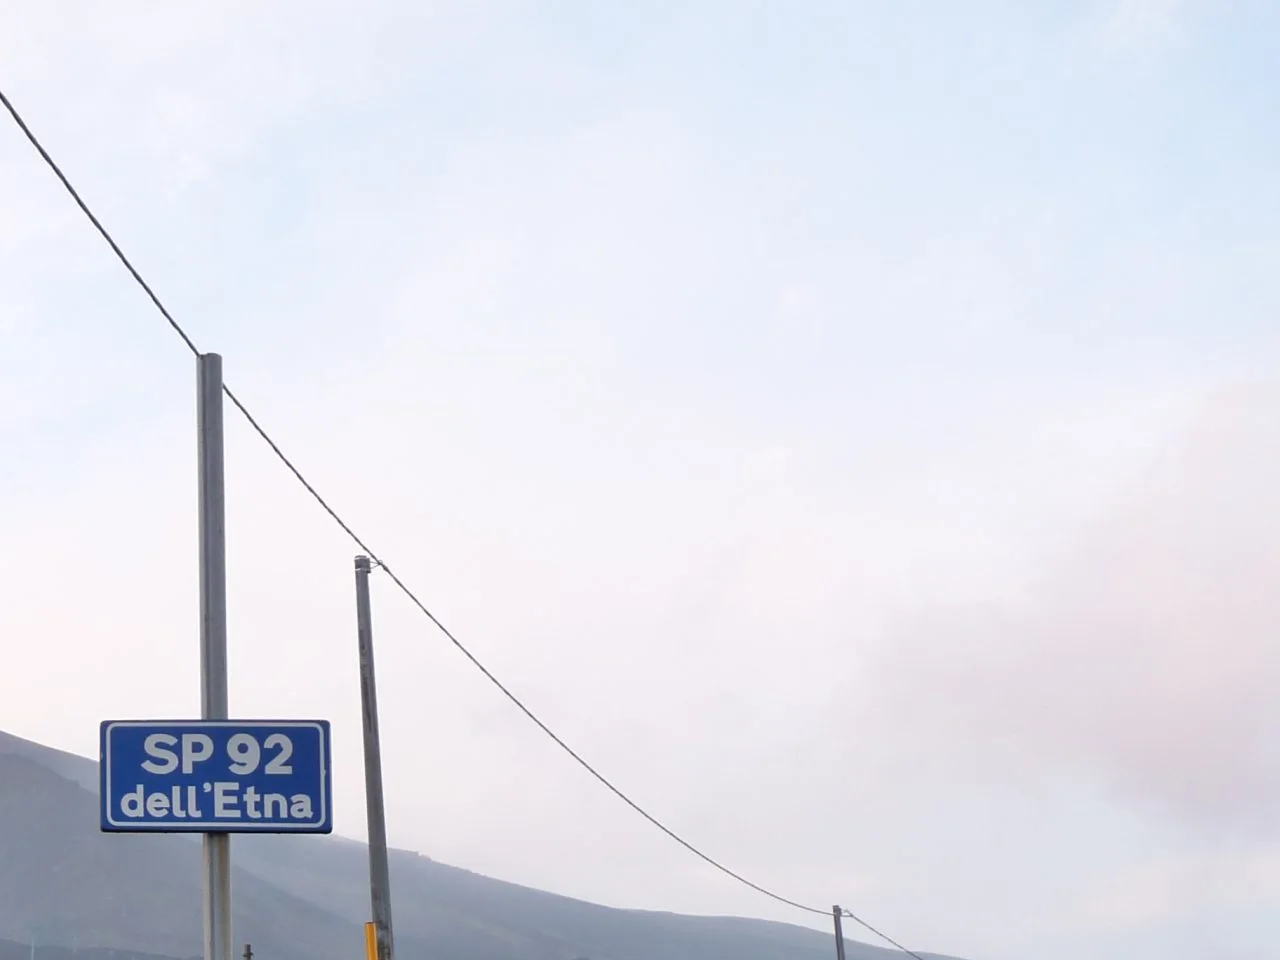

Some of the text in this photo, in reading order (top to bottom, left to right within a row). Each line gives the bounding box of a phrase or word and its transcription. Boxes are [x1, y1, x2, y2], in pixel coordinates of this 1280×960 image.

[140, 733, 293, 775] SP 92
[120, 781, 314, 819] dell'Etna
